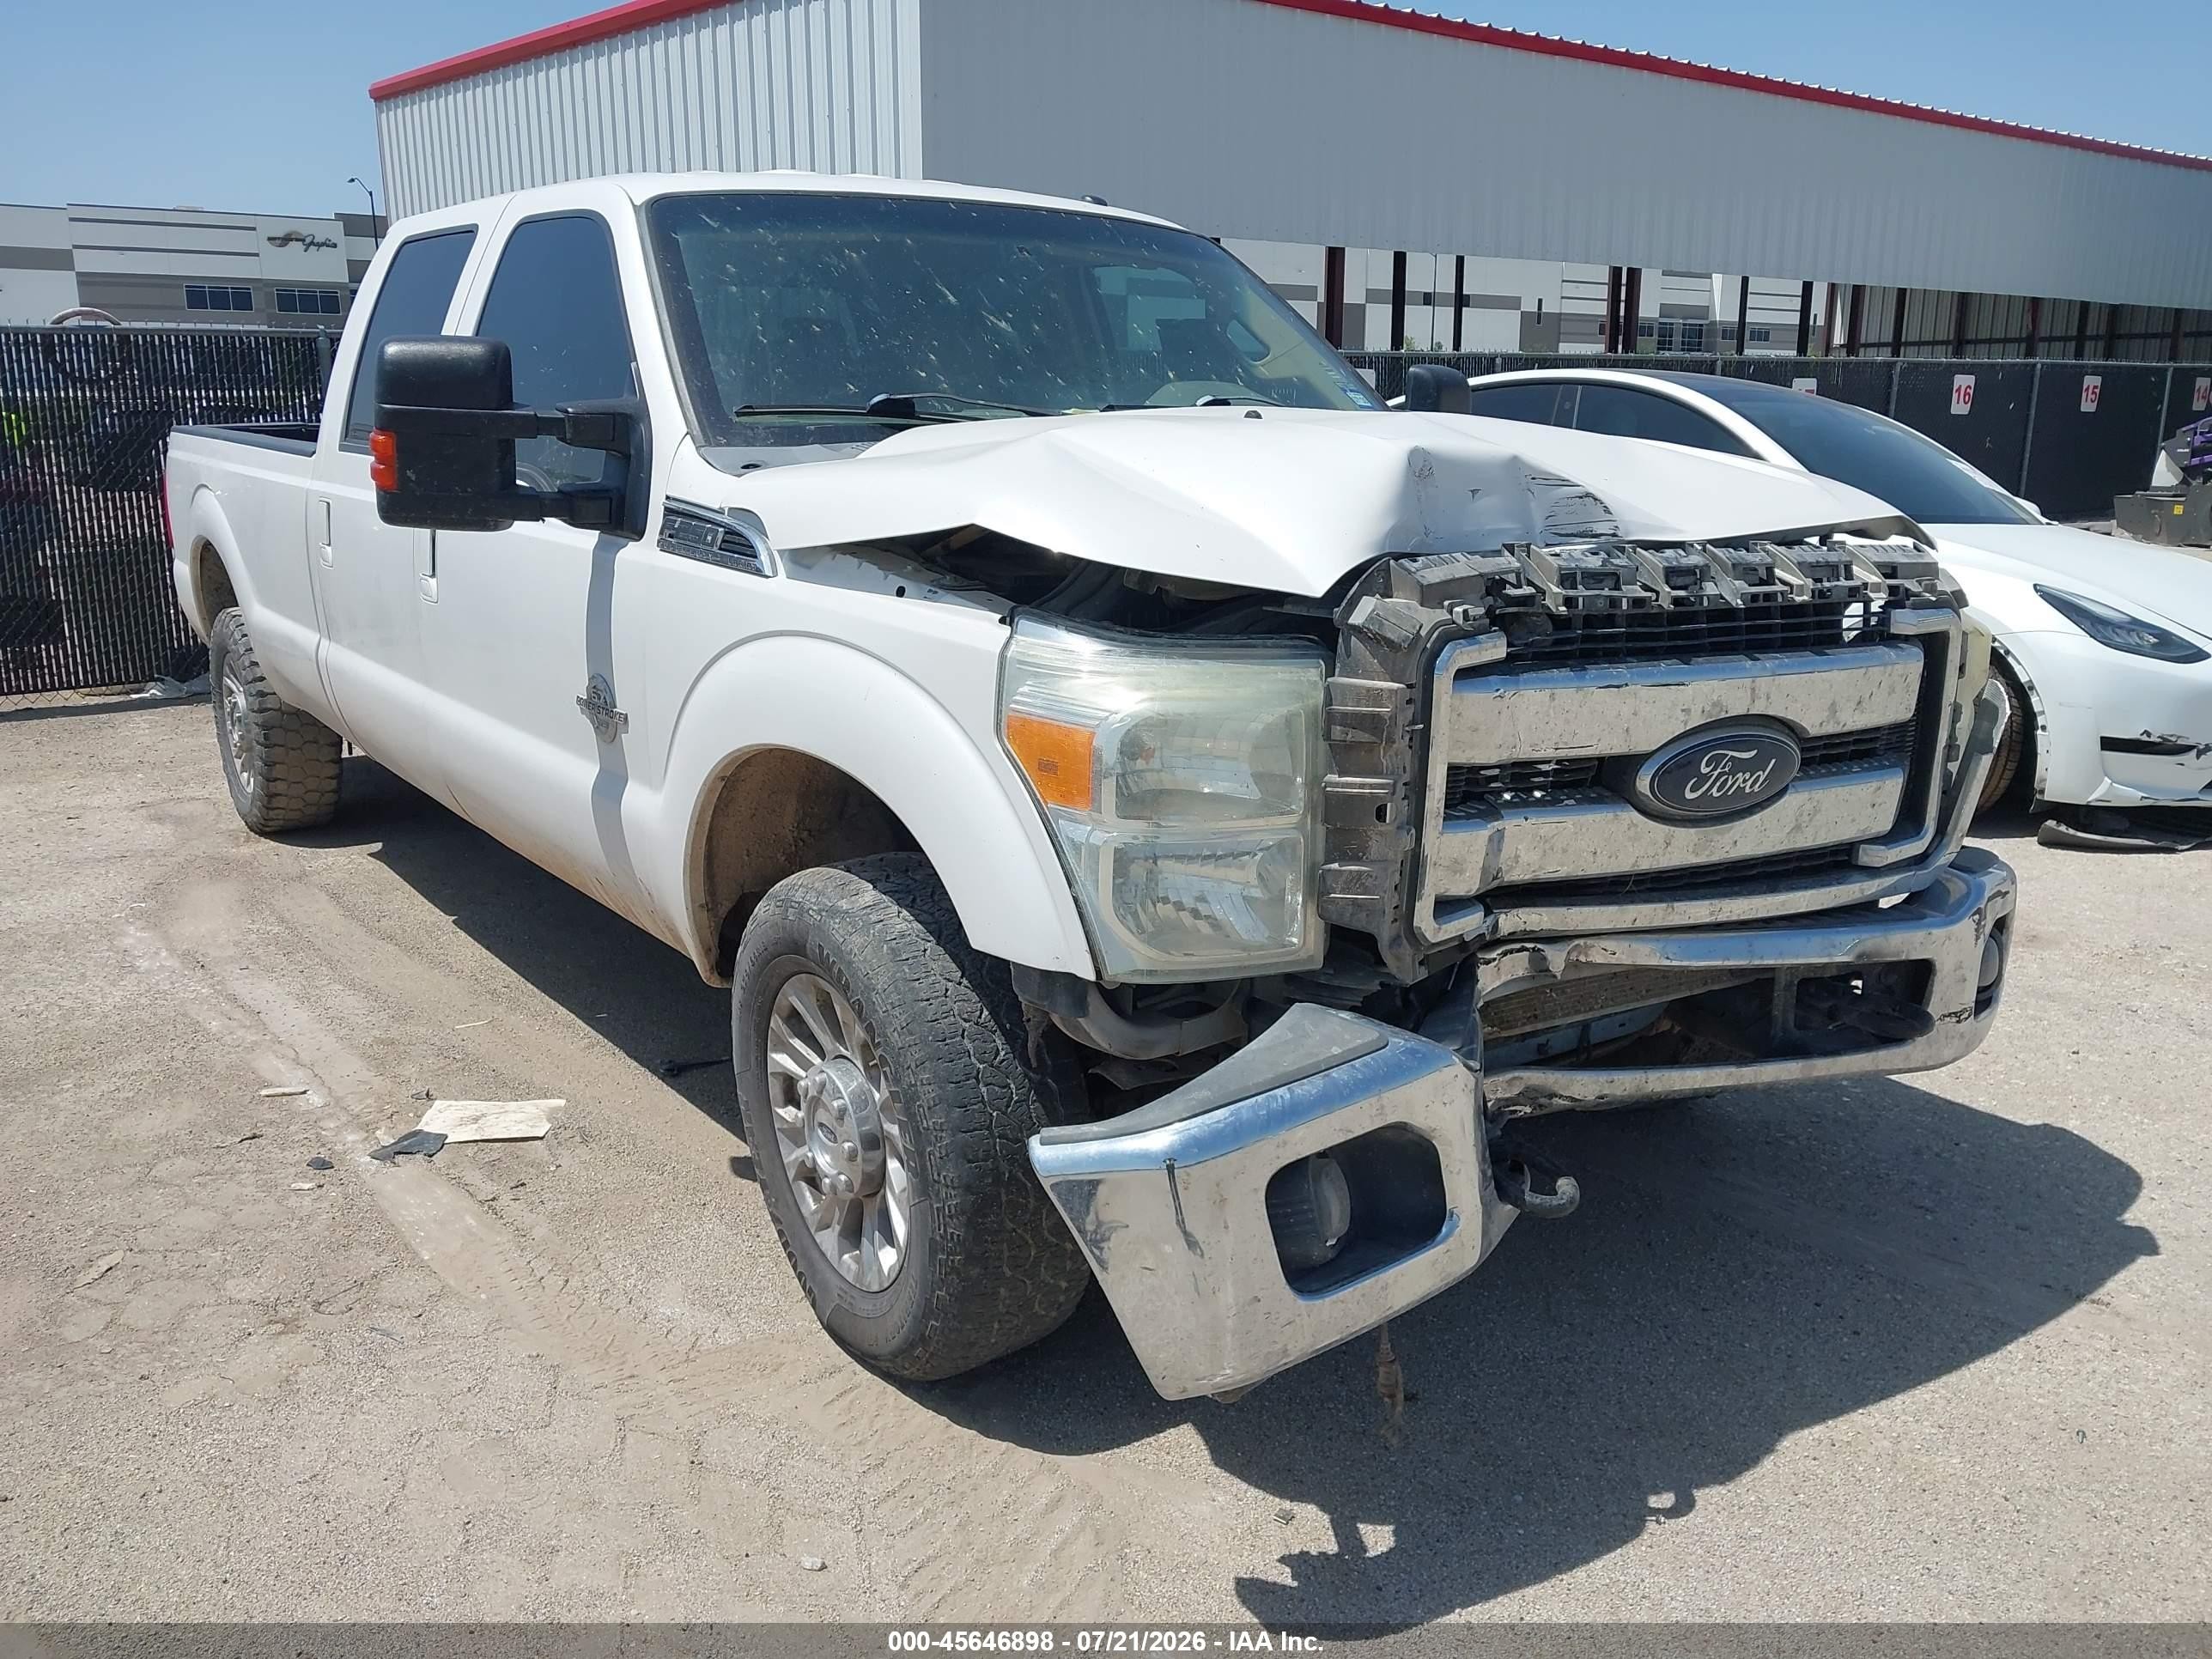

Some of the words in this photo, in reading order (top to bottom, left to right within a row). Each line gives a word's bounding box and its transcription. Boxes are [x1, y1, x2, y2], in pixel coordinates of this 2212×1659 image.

[1954, 384, 1973, 405] 16
[2083, 384, 2100, 404] 15
[2196, 385, 2209, 404] 14
[597, 705, 625, 723] STROKE
[1684, 749, 1777, 799] Ford
